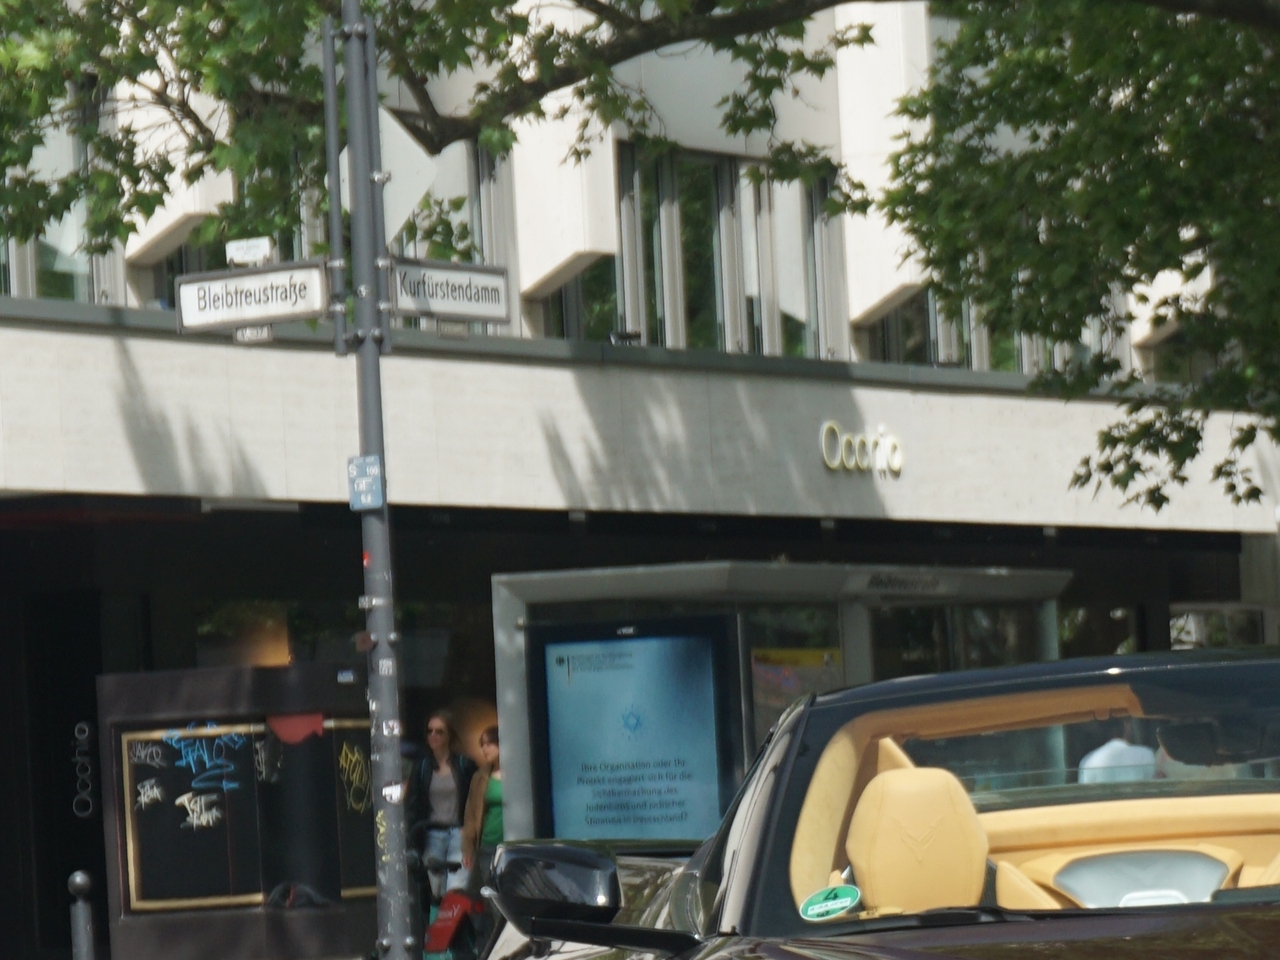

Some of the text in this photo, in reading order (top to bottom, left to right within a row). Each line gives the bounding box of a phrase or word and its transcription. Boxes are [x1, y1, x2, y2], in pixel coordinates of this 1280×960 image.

[197, 274, 307, 312] Bleibtreustraße
[400, 271, 501, 306] Kurfürstendamm
[599, 761, 651, 774] Organisation
[823, 888, 840, 901] 4
